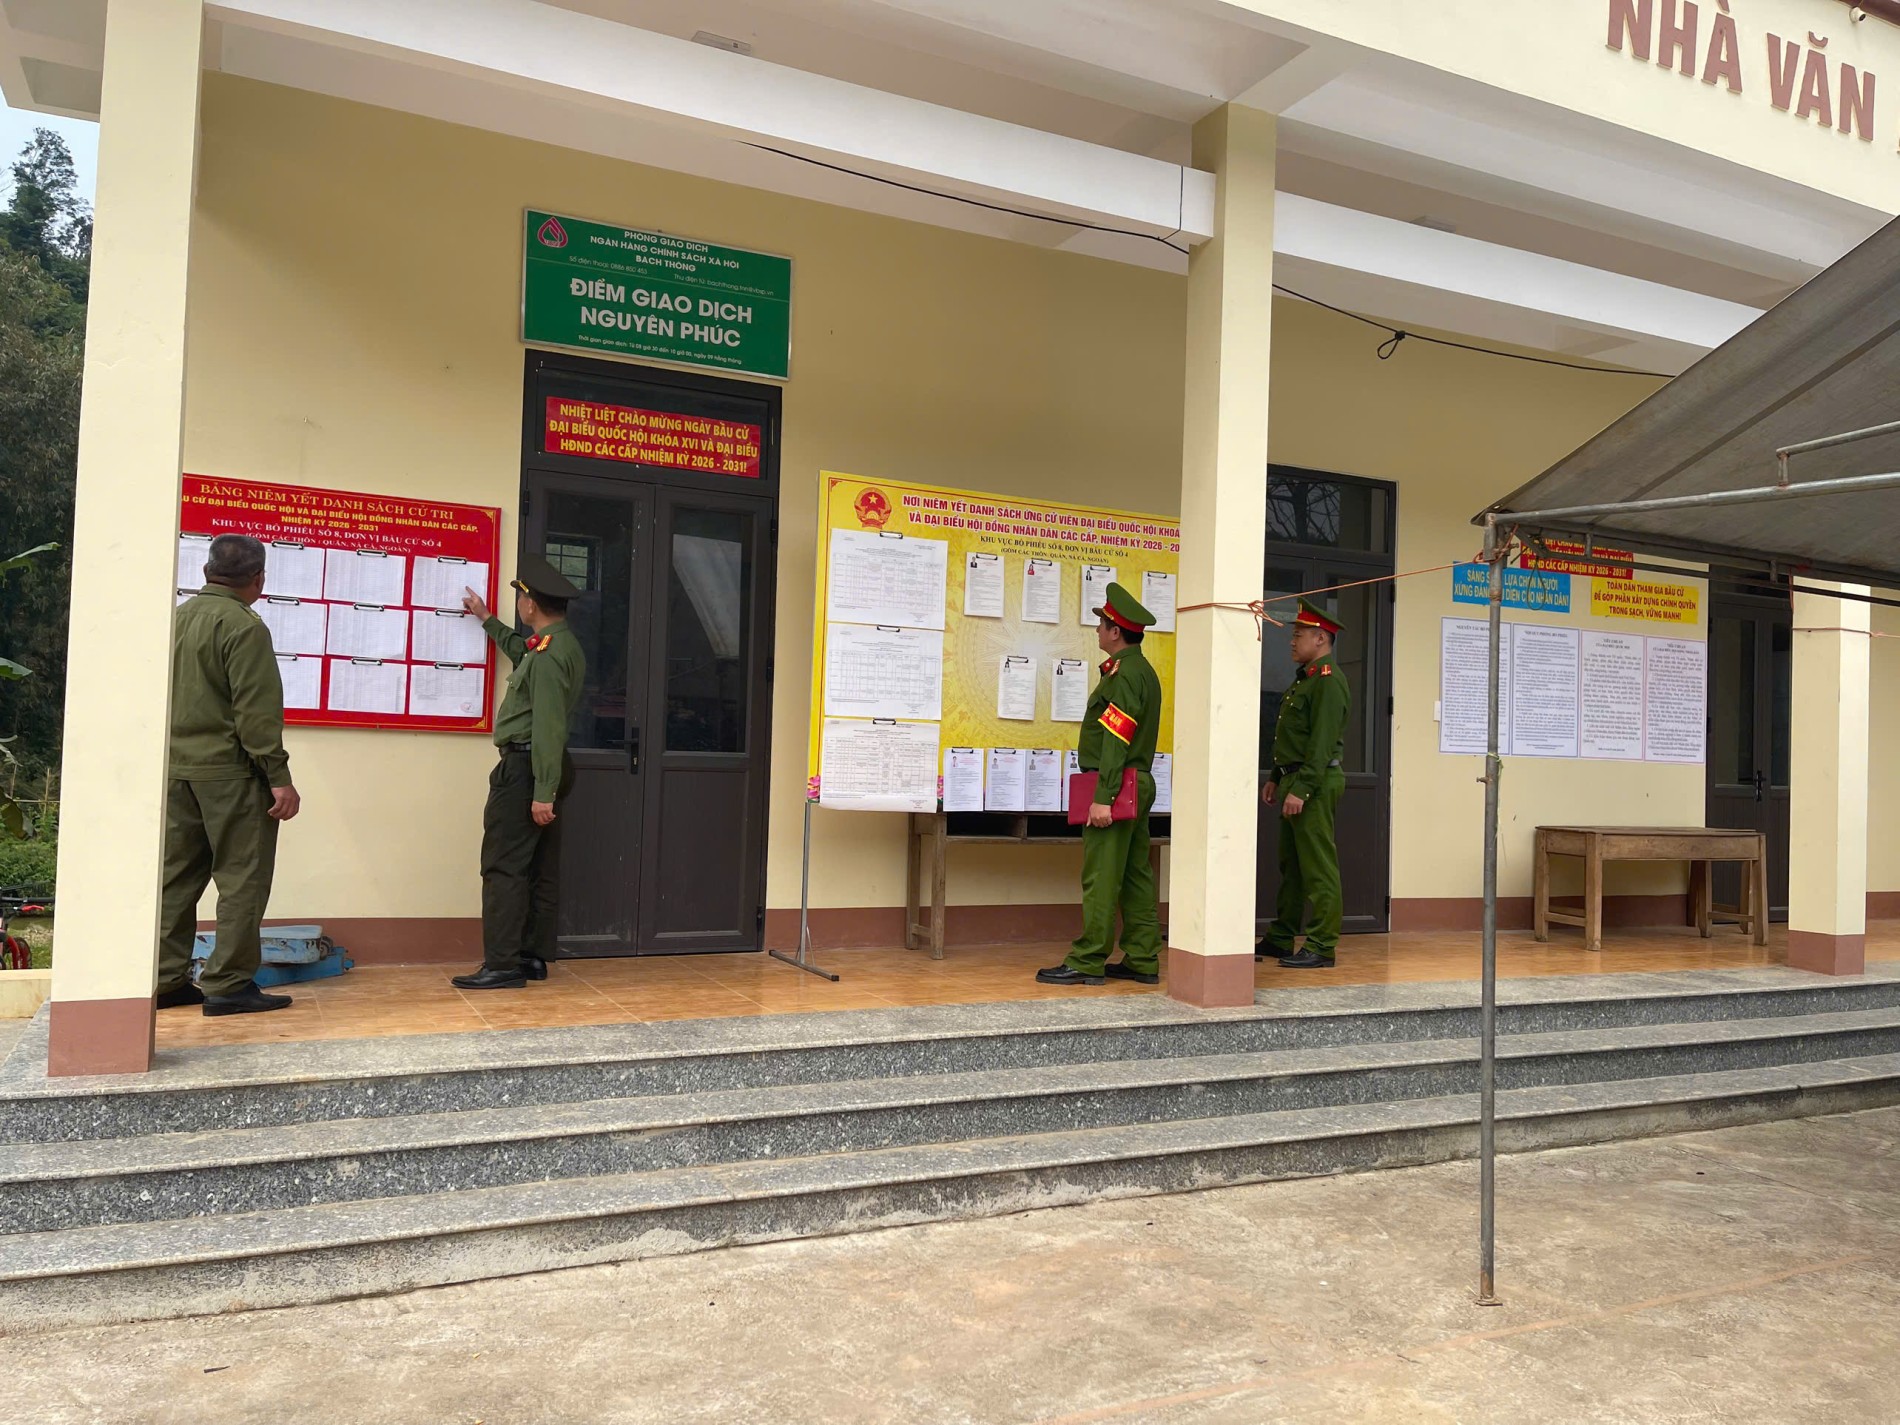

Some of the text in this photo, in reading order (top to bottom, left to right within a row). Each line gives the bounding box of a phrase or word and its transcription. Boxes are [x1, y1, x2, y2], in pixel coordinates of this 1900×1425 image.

[1767, 30, 1876, 141] VĂN
[650, 246, 679, 258] CHÍNH
[681, 251, 707, 263] SÁCH
[660, 237, 684, 248] GIAO
[686, 242, 709, 253] DỊCH
[570, 278, 752, 324] ĐIỂM GIAO DỊCH
[580, 306, 741, 347] NGUYÊN PHÚC
[560, 404, 749, 440] NHIỆT LIỆT CHÀO MỪNG NGÀY BẦU CỬ
[550, 420, 758, 458] ĐẠI BIỂU QUỐC HỘI KHÓA XVI VÀ ĐẠI BIỂU
[560, 438, 747, 473] HĐND CÁC CẤP NHIỆM KỲ 2026 2031!
[192, 495, 206, 504] CỬ
[208, 498, 224, 507] ĐẠI
[227, 498, 249, 509] BIỂU
[251, 501, 277, 512] QUỐC
[278, 506, 295, 514] HỘI
[297, 506, 309, 515] VÀ
[312, 509, 326, 518] ĐẠI
[329, 510, 350, 520] BIỂU
[352, 512, 367, 522] HỘI
[369, 514, 394, 524] ĐỒNG
[395, 517, 420, 528] NHÂN
[422, 519, 440, 529] DÂN
[442, 520, 459, 530] CÁC
[200, 482, 454, 520] BẢNG NIÊM YẾT DANH SÁCH CỬ TRI
[903, 496, 920, 507] NƠI
[923, 498, 948, 510] NIÊM
[951, 500, 967, 512] YẾT
[970, 504, 994, 516] DANH
[998, 506, 1022, 520] SÁCH
[1024, 509, 1042, 522] ỨNG
[1044, 512, 1058, 523] CỬ
[1059, 514, 1079, 526] VIÊN
[1081, 518, 1095, 530] ĐẠI
[1098, 518, 1116, 530] BIỂU
[1118, 520, 1141, 534] QUỐC
[1142, 524, 1156, 536] HỘI
[212, 518, 237, 528] KHU
[238, 520, 263, 531] VỰC
[284, 524, 316, 535] PHIẾU
[318, 526, 332, 538] SỐ
[334, 530, 342, 539] 8,
[344, 532, 366, 540] ĐƠN
[369, 534, 380, 543] VỊ
[382, 534, 403, 544] BẦU
[422, 538, 435, 548] SỐ
[281, 516, 379, 532] NHIỆM KỲ 2026 2031
[909, 512, 922, 524] VÀ
[924, 514, 940, 527] ĐẠI
[943, 515, 965, 528] BIỂU
[967, 519, 983, 532] HỘI
[986, 520, 1010, 534] ĐỒNG
[1012, 524, 1038, 537] NHÂN
[1040, 527, 1058, 540] DÂN
[1060, 529, 1078, 541] CÁC
[1100, 534, 1128, 548] NHIỆM
[1130, 538, 1141, 548] KỲ
[1142, 540, 1162, 551] 2026
[1170, 543, 1180, 553] 20
[997, 538, 1012, 546] VỰC
[1467, 568, 1486, 583] SÁNG
[1546, 559, 1556, 571] CÁC
[1557, 560, 1568, 572] CẤP
[1596, 565, 1609, 575] 2026
[1454, 580, 1473, 596] XỨNG
[1474, 584, 1490, 598] ĐÁN
[1602, 591, 1614, 602] GÓP
[1614, 592, 1631, 604] PHẦN
[1632, 594, 1642, 605] XÂY
[1660, 597, 1678, 608] CHÍNH
[1624, 582, 1636, 592] DÂN
[1637, 584, 1654, 594] THAM
[1654, 586, 1664, 594] GIA
[1664, 586, 1676, 596] BẦU
[1609, 606, 1628, 616] TRONG
